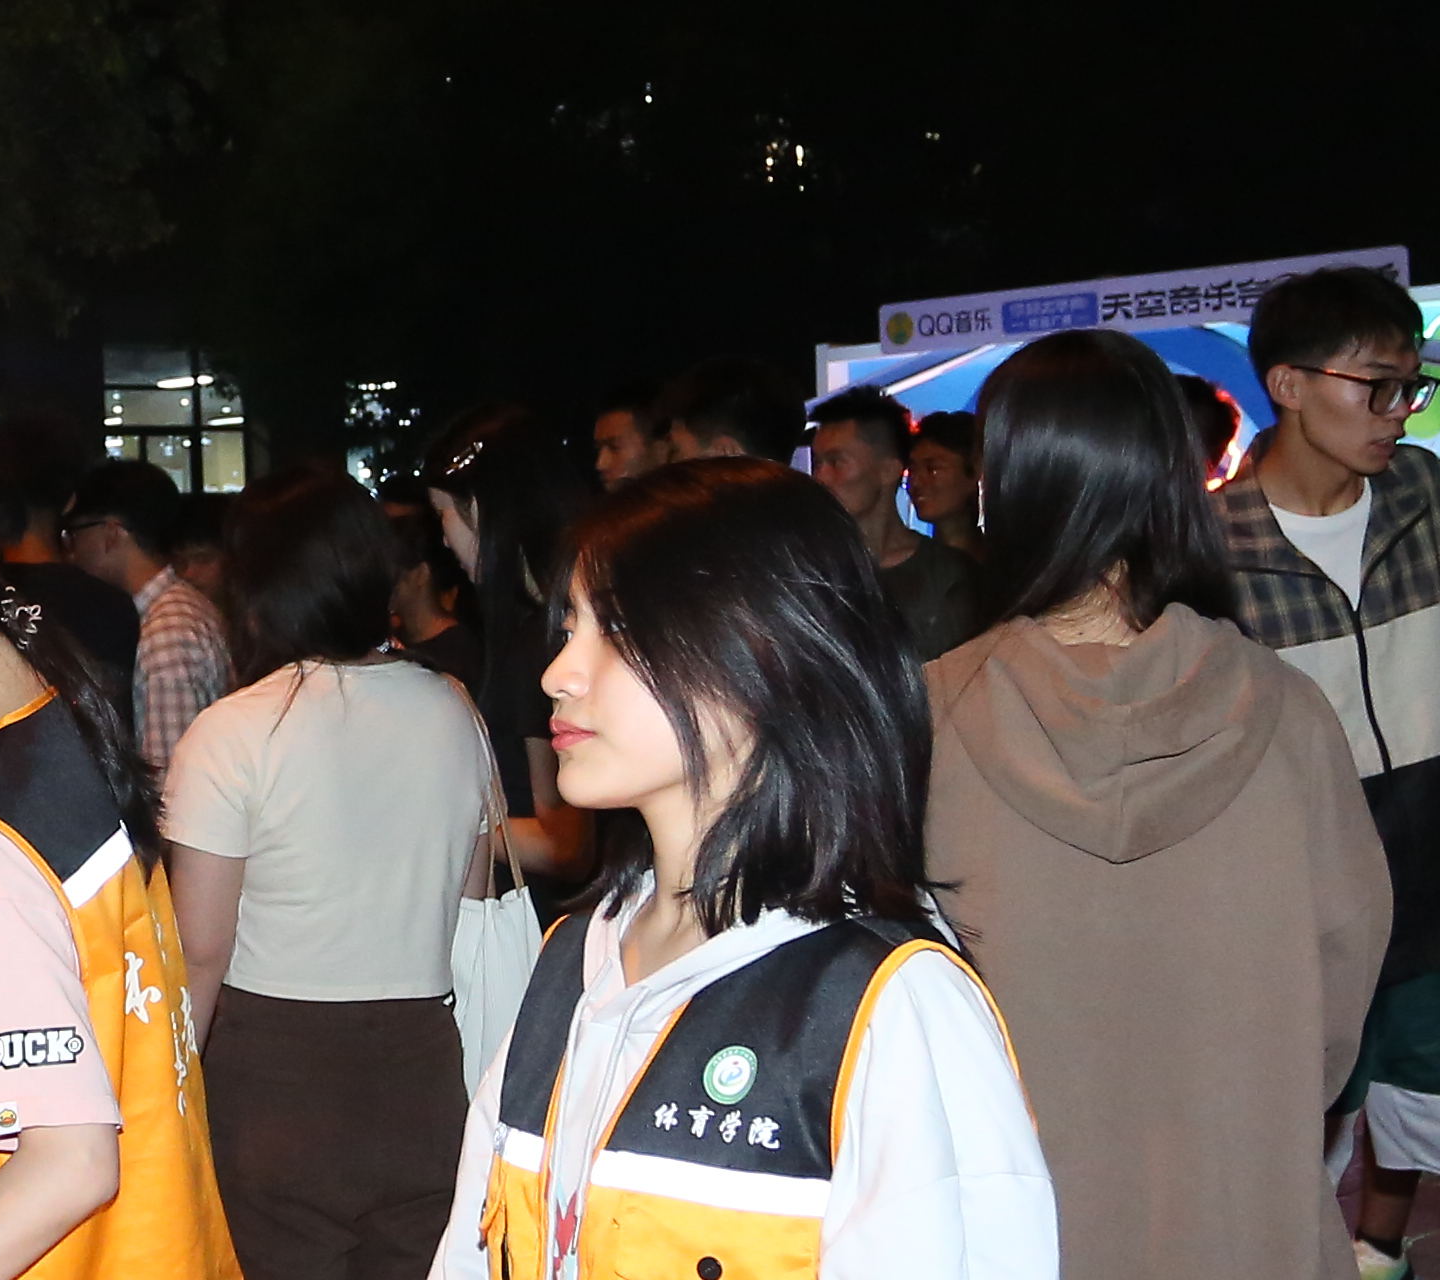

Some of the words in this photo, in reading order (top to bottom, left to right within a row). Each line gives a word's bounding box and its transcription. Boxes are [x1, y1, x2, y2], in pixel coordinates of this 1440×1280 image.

[918, 307, 992, 337] QQ音乐
[654, 1102, 780, 1150] 体育学院
